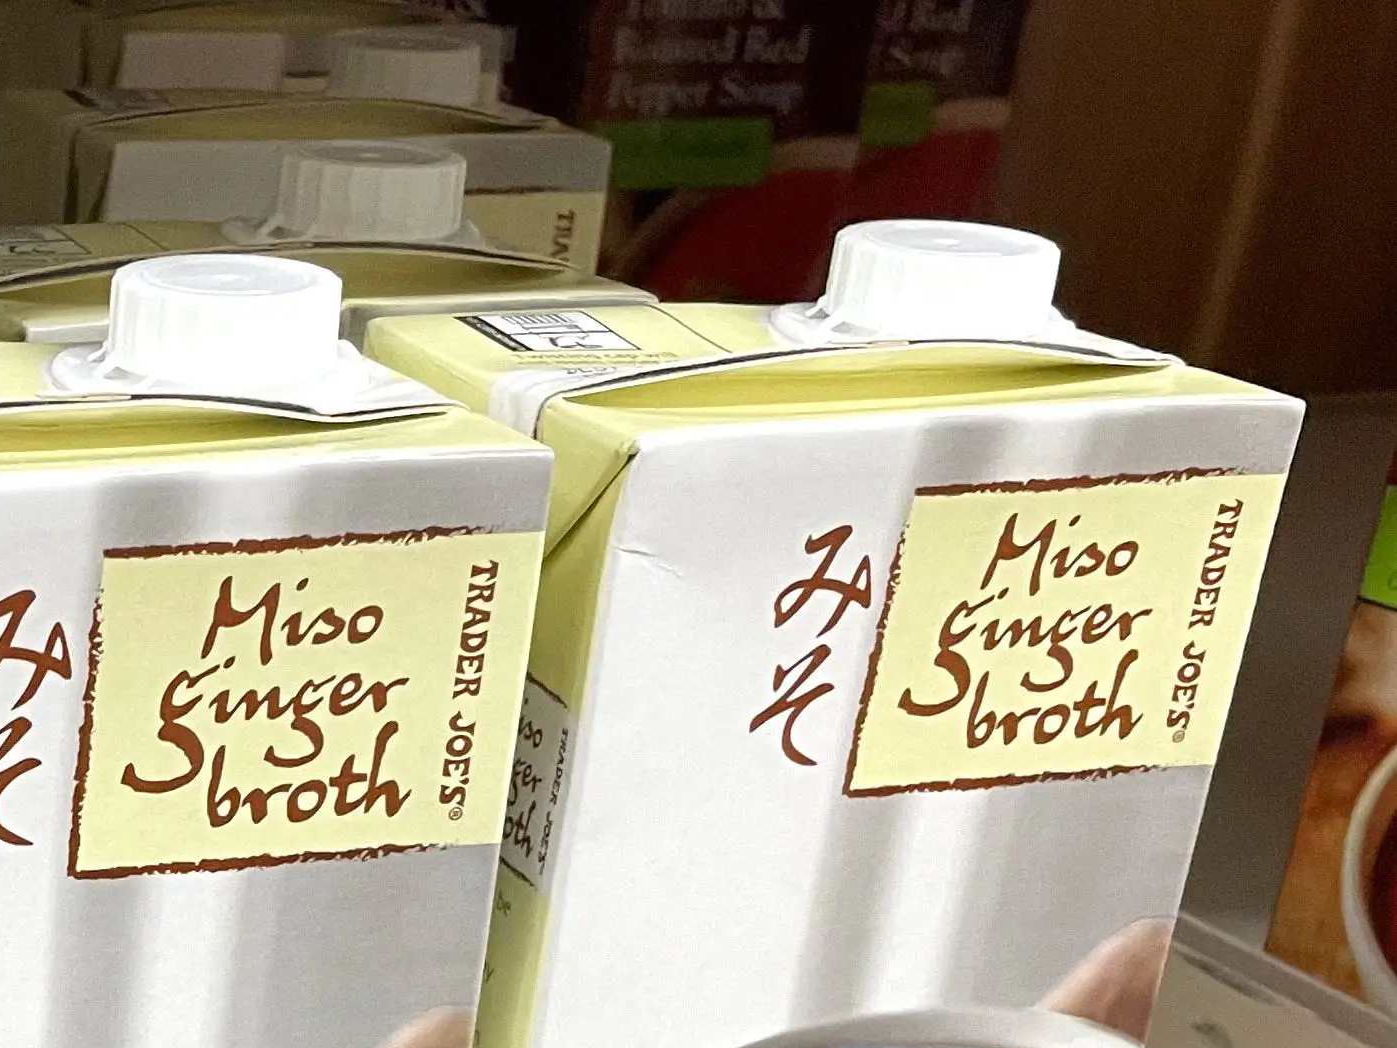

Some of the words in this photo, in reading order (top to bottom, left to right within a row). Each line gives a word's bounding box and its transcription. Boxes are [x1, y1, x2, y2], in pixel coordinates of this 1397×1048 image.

[980, 513, 1138, 595] Miso
[1188, 499, 1243, 630] TRADER
[202, 576, 383, 665] Miso
[453, 560, 499, 698] TRADER
[750, 525, 871, 765] みそ
[898, 587, 1152, 716] Ginger
[121, 657, 410, 792] Ginger
[967, 649, 1144, 748] broth
[209, 720, 411, 827] broth
